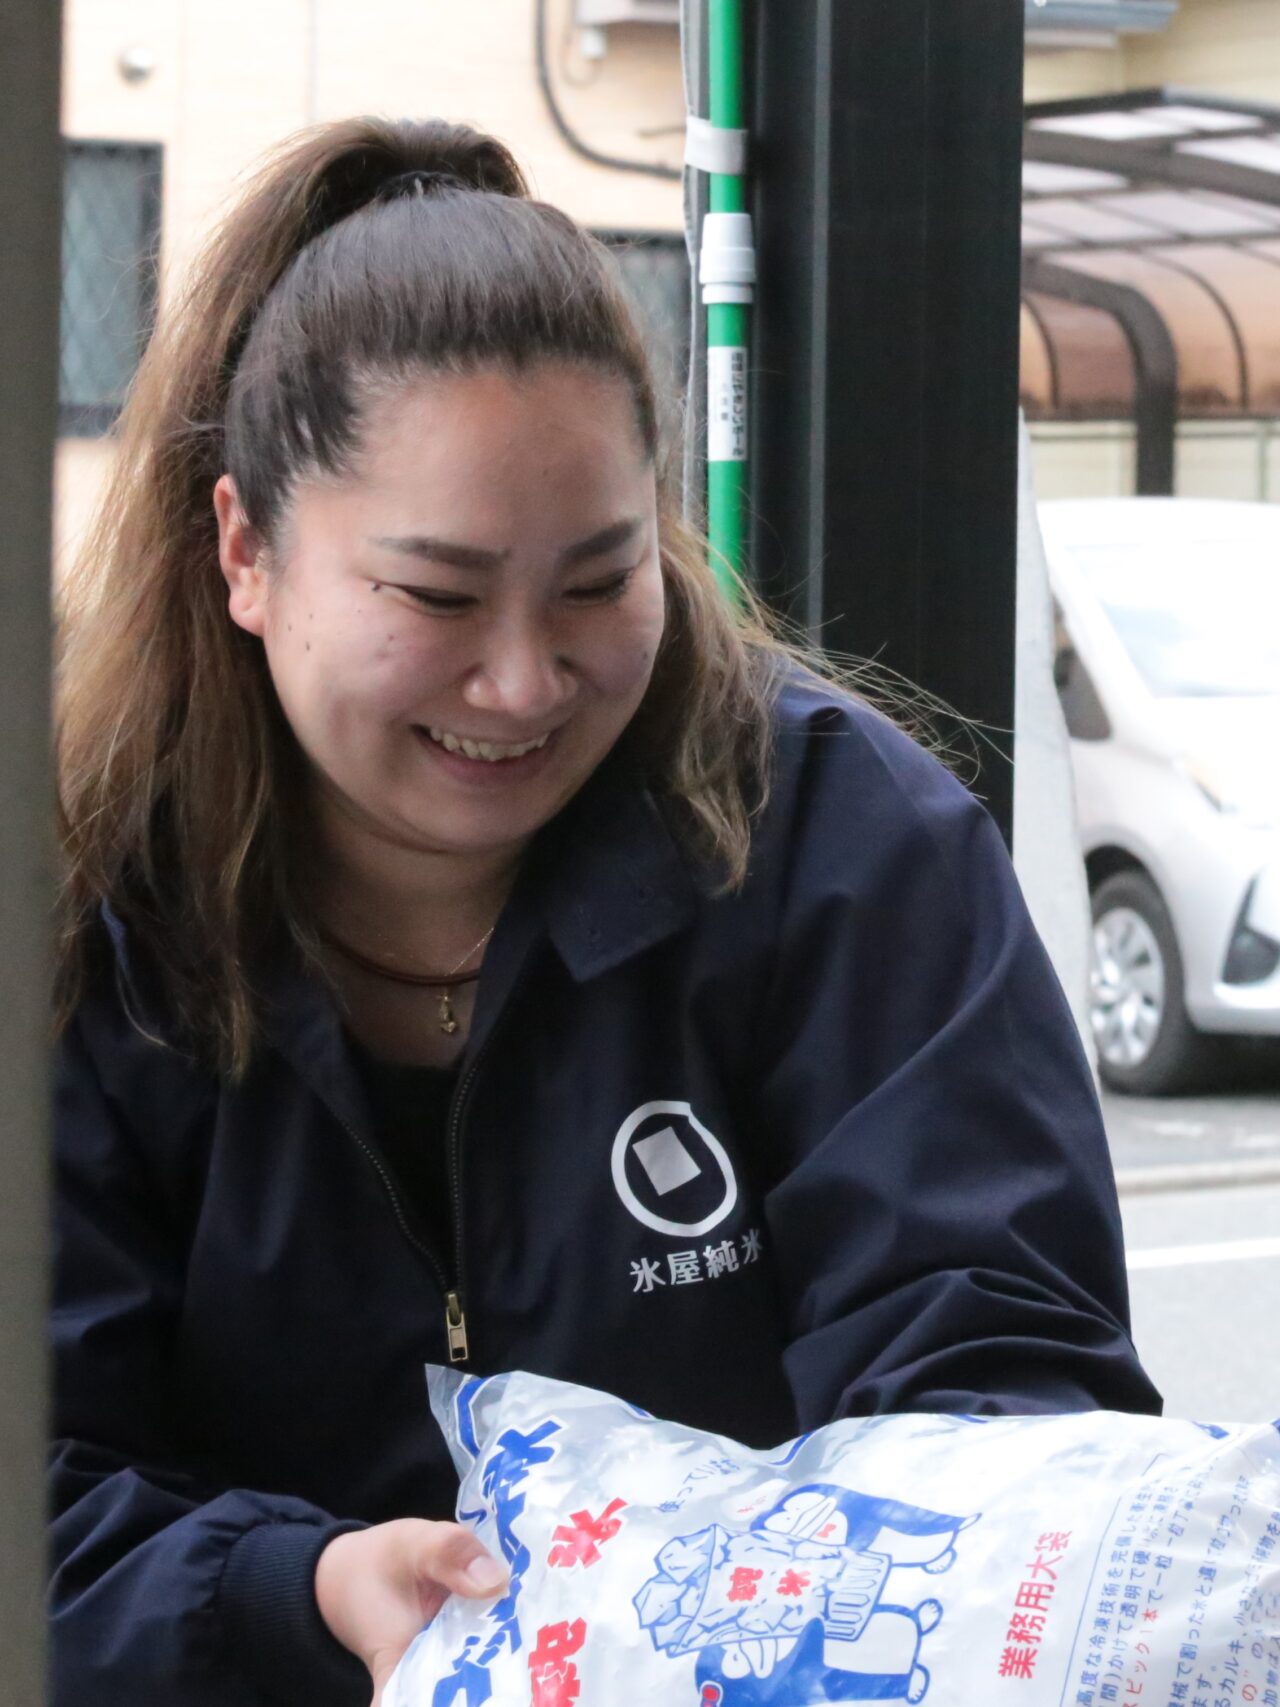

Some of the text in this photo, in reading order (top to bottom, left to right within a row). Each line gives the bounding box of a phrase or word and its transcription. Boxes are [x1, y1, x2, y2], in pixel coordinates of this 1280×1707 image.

[629, 1229, 763, 1293] 氷屋純氷
[998, 1530, 1073, 1680] 業務用大袋
